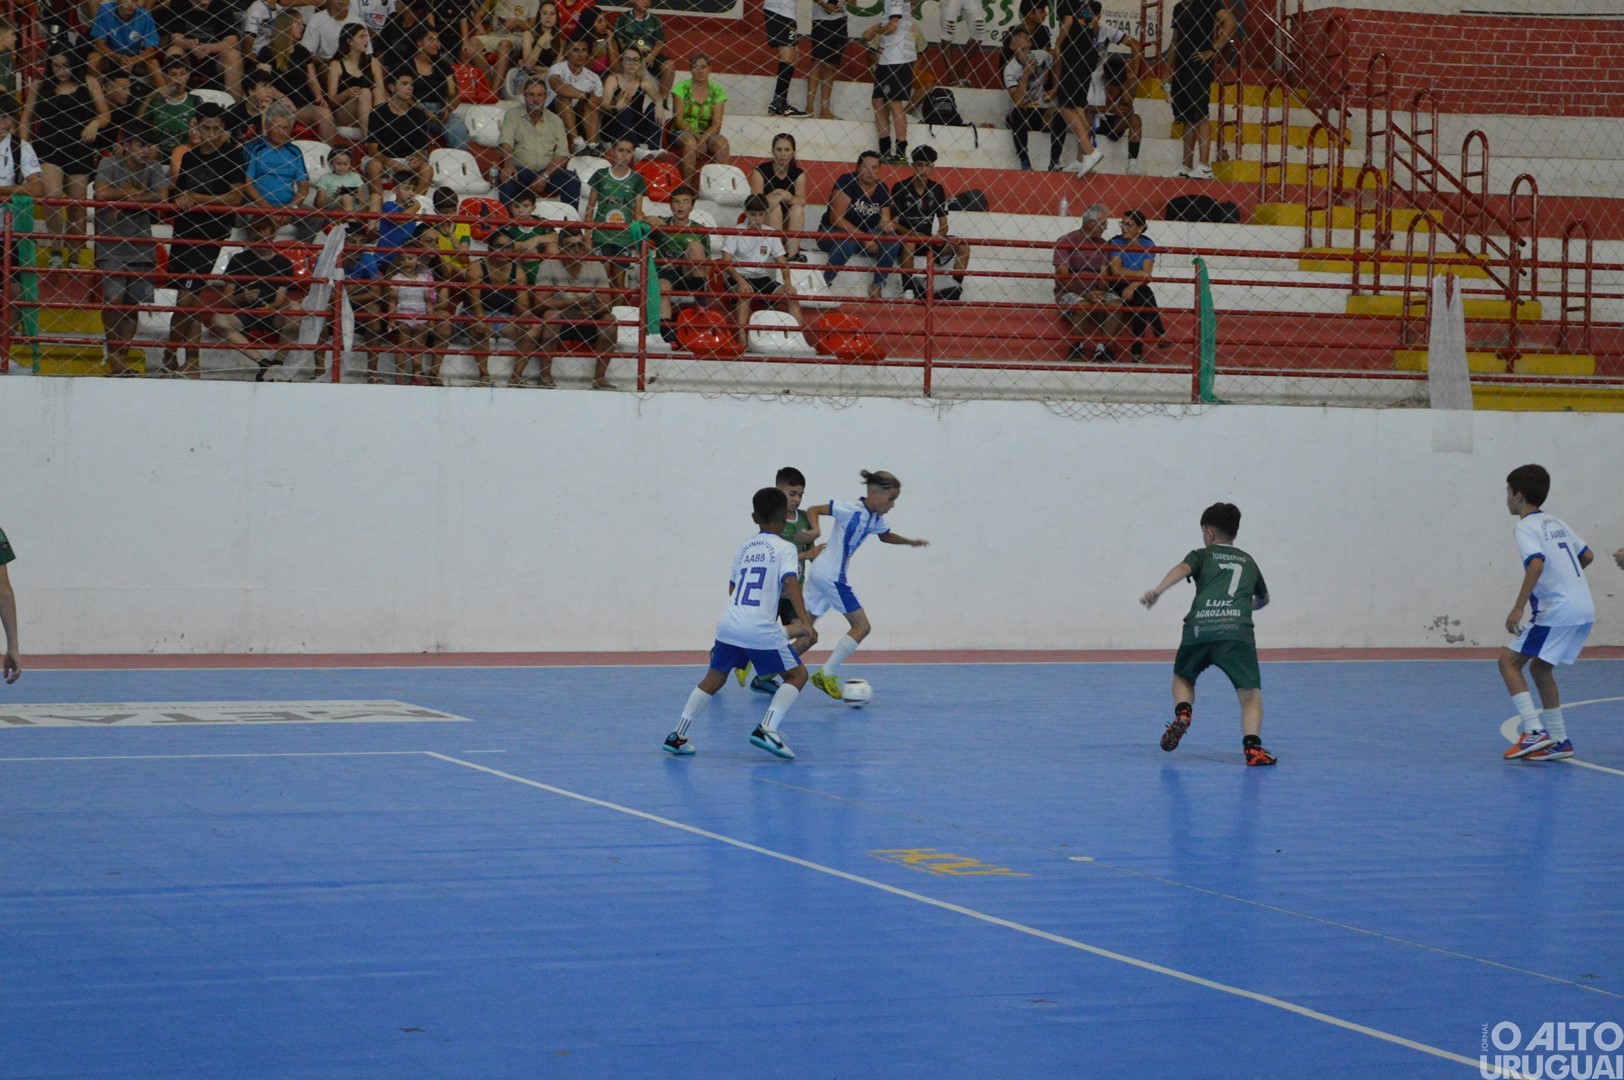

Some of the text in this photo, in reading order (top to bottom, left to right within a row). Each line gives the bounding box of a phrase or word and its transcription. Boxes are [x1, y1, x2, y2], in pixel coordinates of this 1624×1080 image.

[744, 553, 766, 563] AABB
[1557, 542, 1580, 577] 7
[734, 567, 767, 606] 12
[1218, 562, 1243, 597] 7
